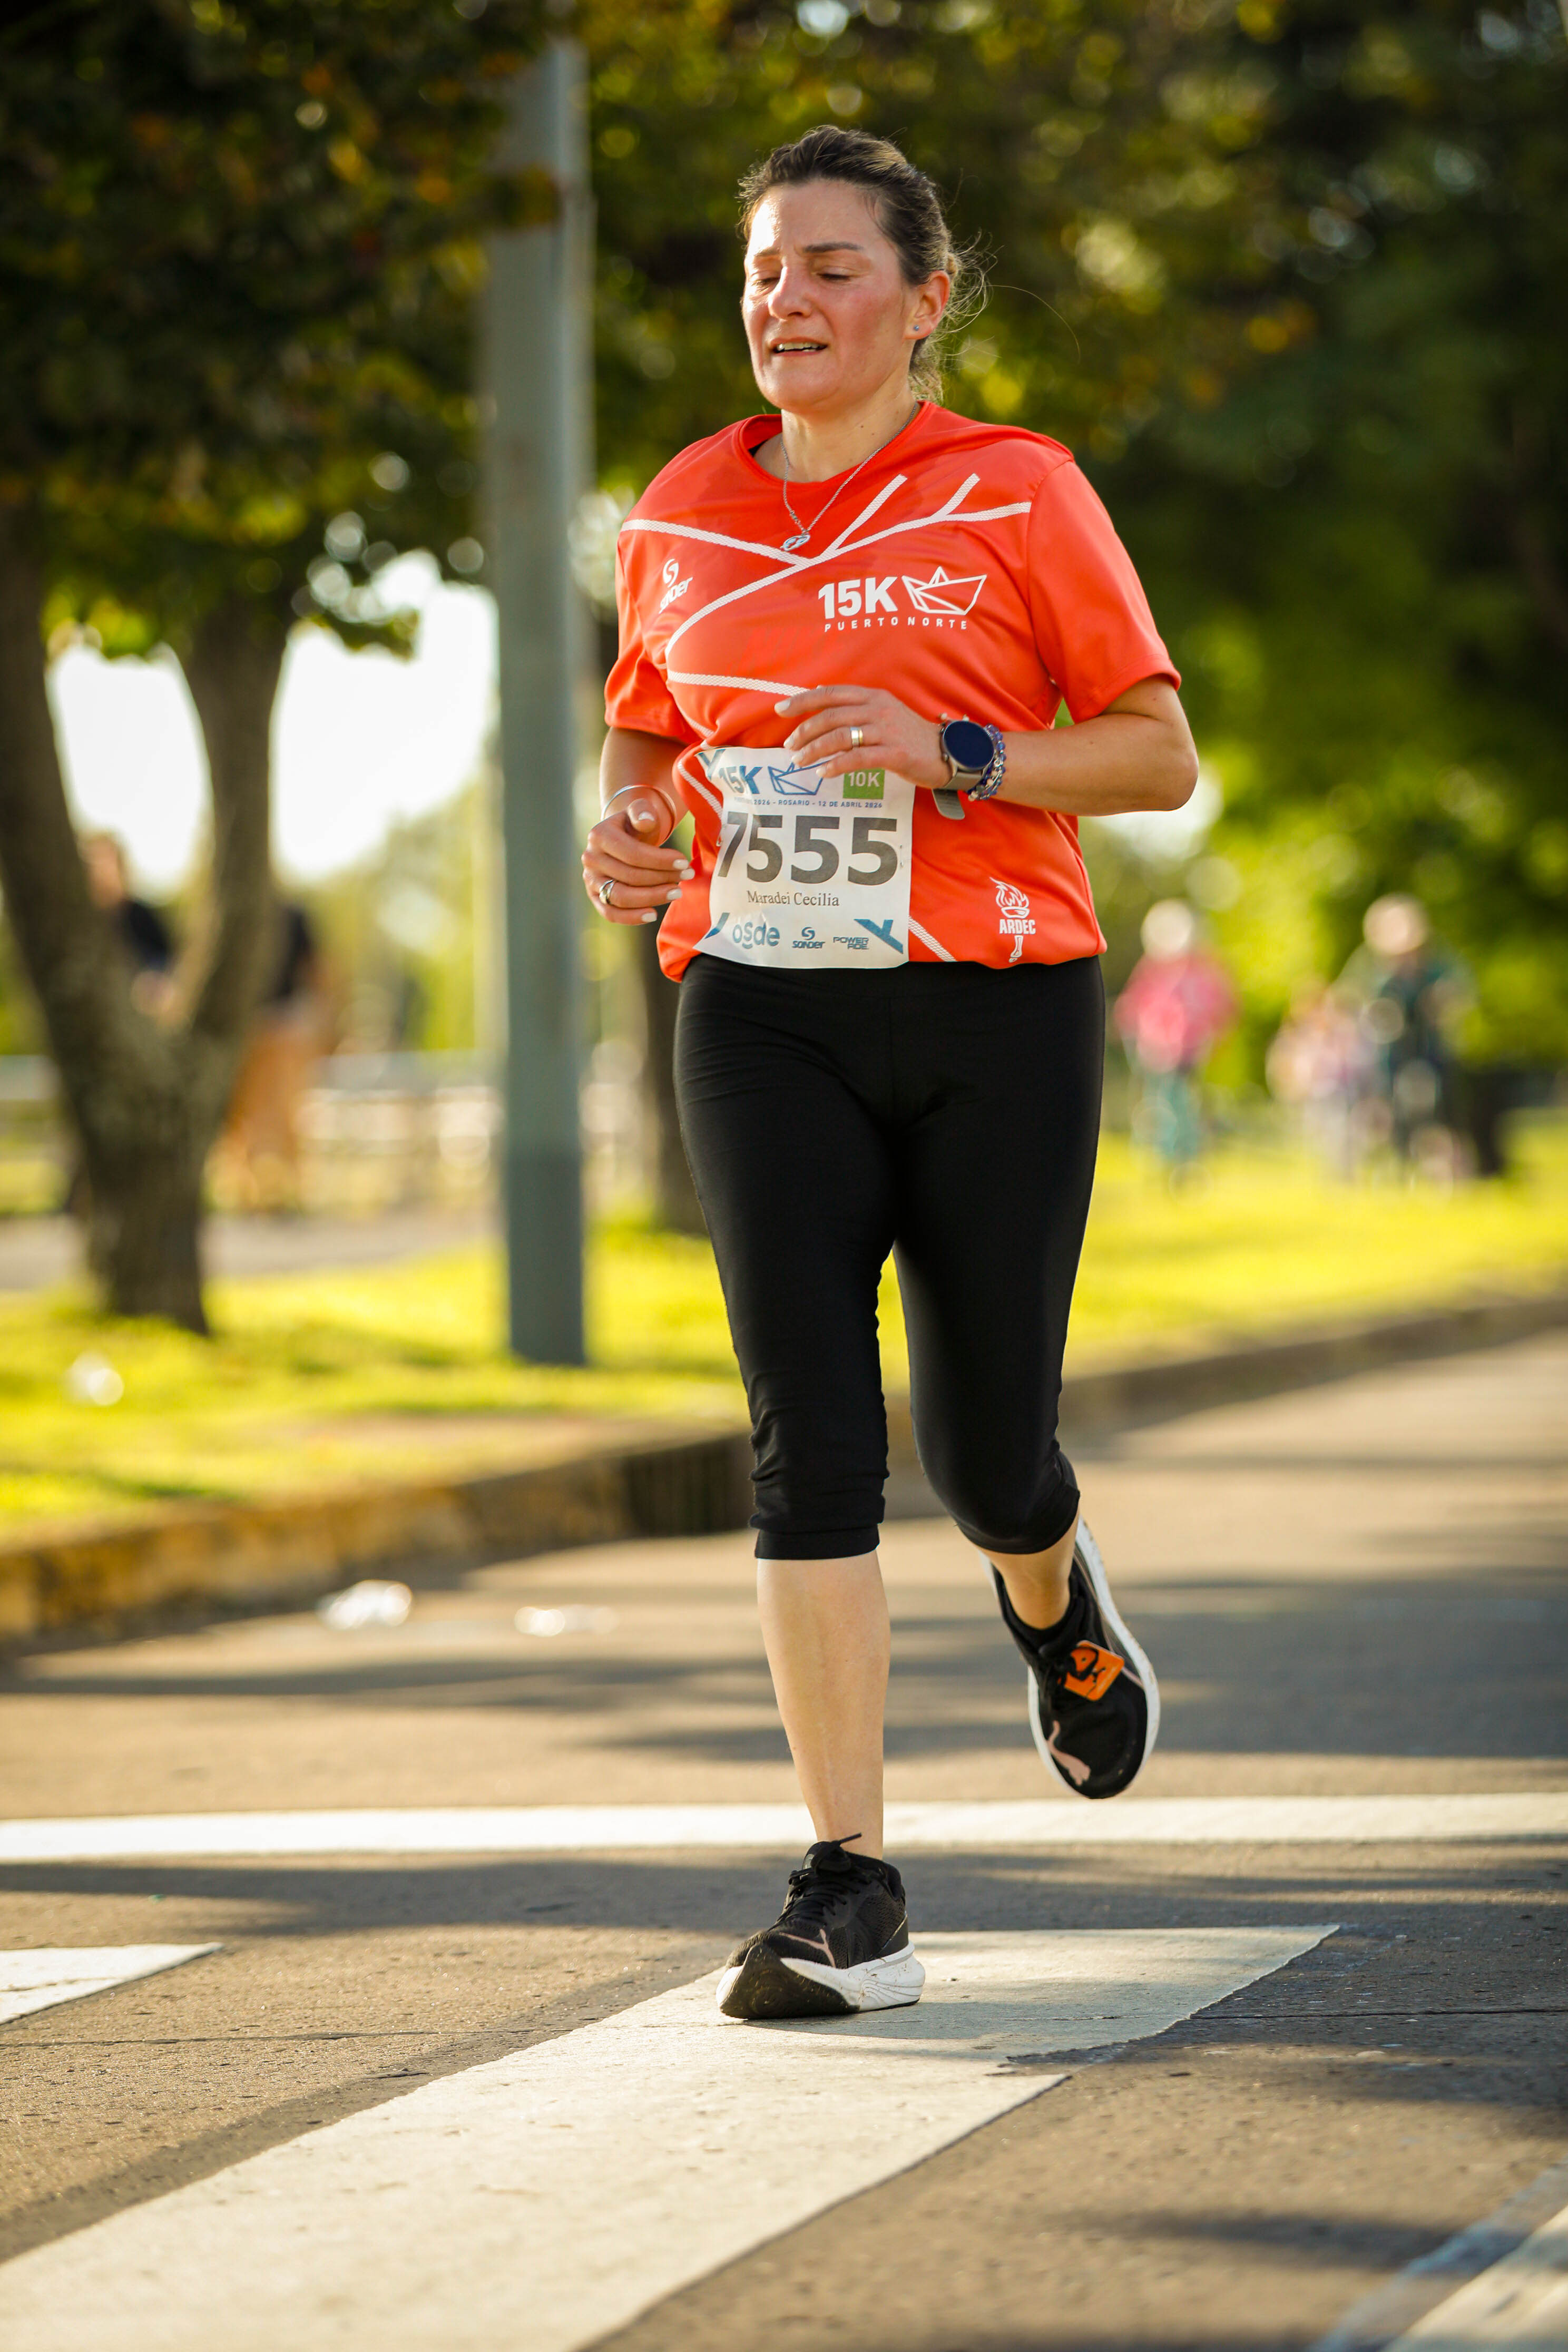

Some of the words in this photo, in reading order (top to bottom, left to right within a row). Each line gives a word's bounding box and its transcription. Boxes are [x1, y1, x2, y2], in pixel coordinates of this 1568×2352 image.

[818, 576, 898, 620] 15K
[825, 616, 898, 633] PUERTO
[907, 616, 967, 630] NORTE
[719, 765, 763, 795] 15K
[847, 771, 881, 787] 10K
[717, 811, 898, 886] 7555
[746, 890, 790, 905] Maradei
[793, 892, 839, 906] Cecilia
[732, 922, 780, 947] osde
[999, 918, 1036, 935] ARDEC
